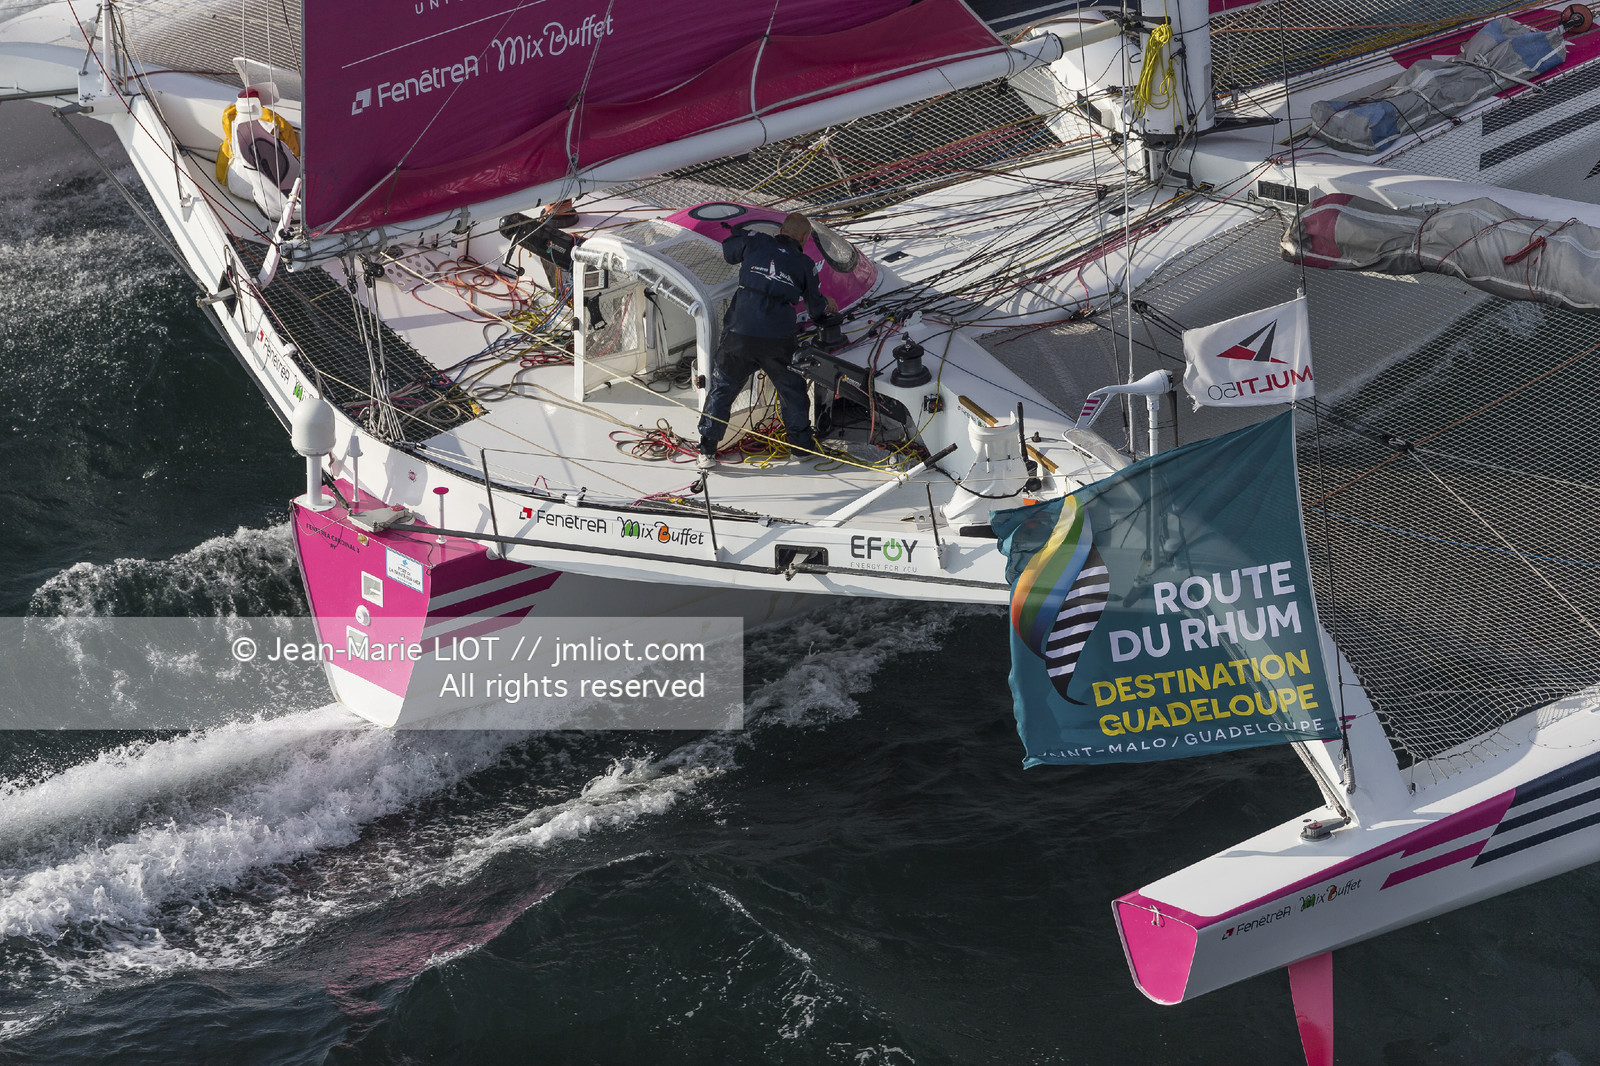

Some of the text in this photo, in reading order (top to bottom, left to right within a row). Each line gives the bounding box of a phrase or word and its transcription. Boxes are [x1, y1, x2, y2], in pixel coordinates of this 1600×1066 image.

[491, 35, 543, 72] Mix
[543, 14, 614, 56] Buffet
[617, 516, 653, 540] Mix
[654, 521, 704, 546] Buffet
[850, 535, 918, 562] EFOY
[850, 561, 881, 570] ENERGY
[1153, 560, 1296, 615] ROUTE
[1108, 601, 1302, 662] DU RHUM
[1092, 649, 1311, 708] DESTINATION
[1099, 684, 1319, 736] GUADELOUPE
[1299, 893, 1326, 912] Mix
[1326, 878, 1361, 902] Buffet
